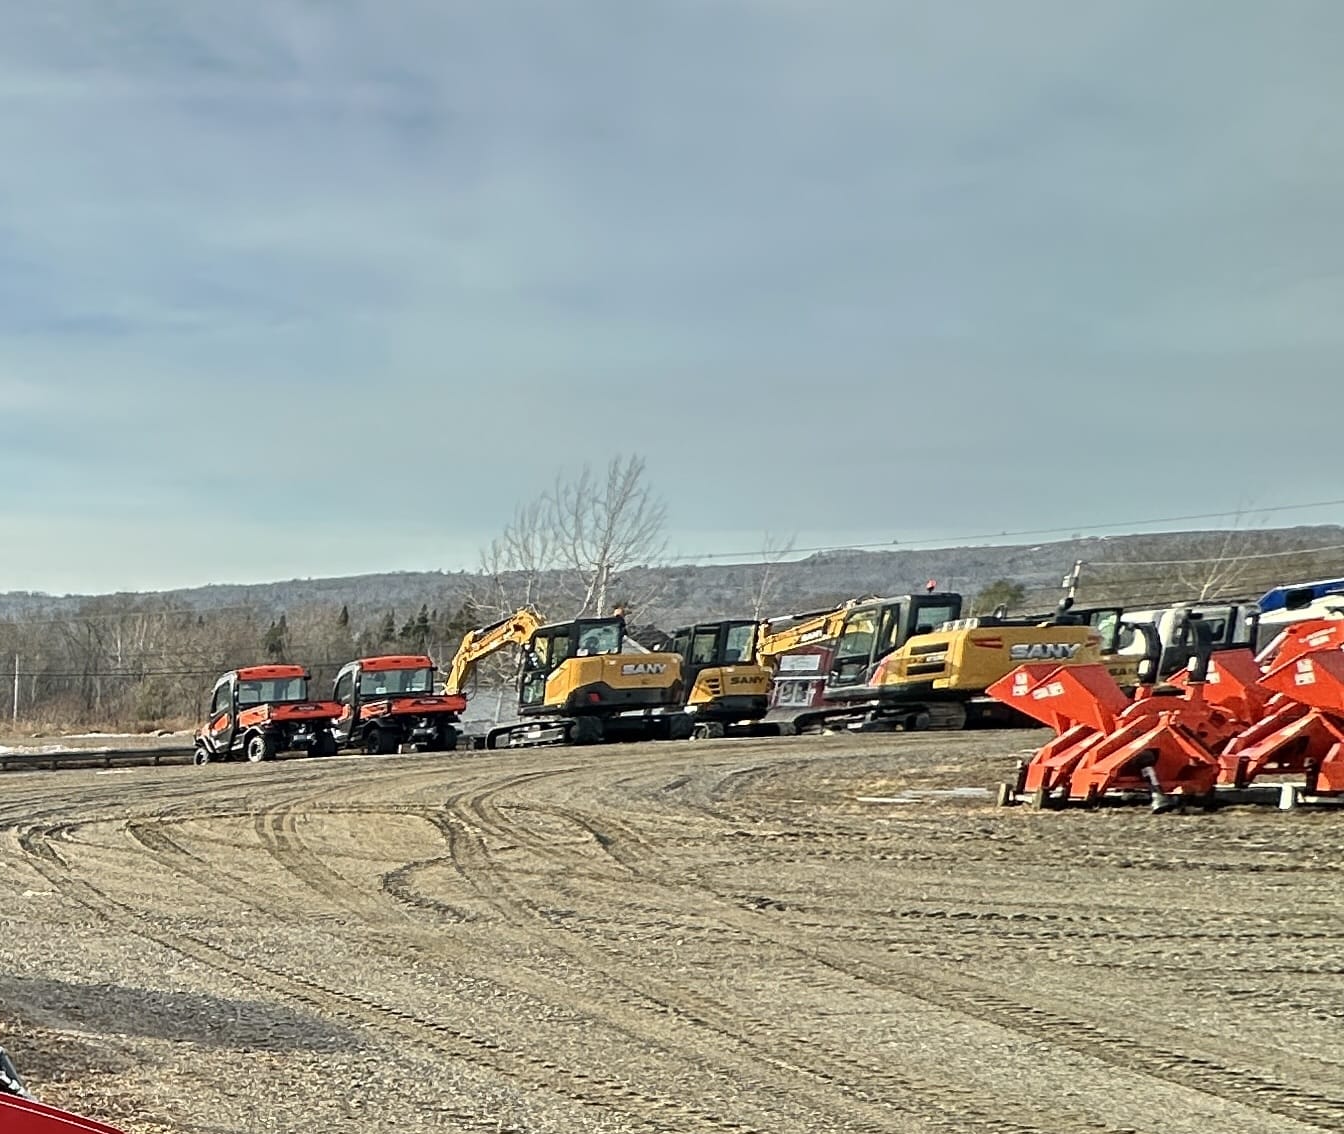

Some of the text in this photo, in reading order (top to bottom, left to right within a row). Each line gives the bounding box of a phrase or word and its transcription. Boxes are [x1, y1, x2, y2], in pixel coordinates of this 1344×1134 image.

[1009, 643, 1081, 660] SANY
[622, 663, 667, 676] SANY
[730, 676, 765, 685] SANY
